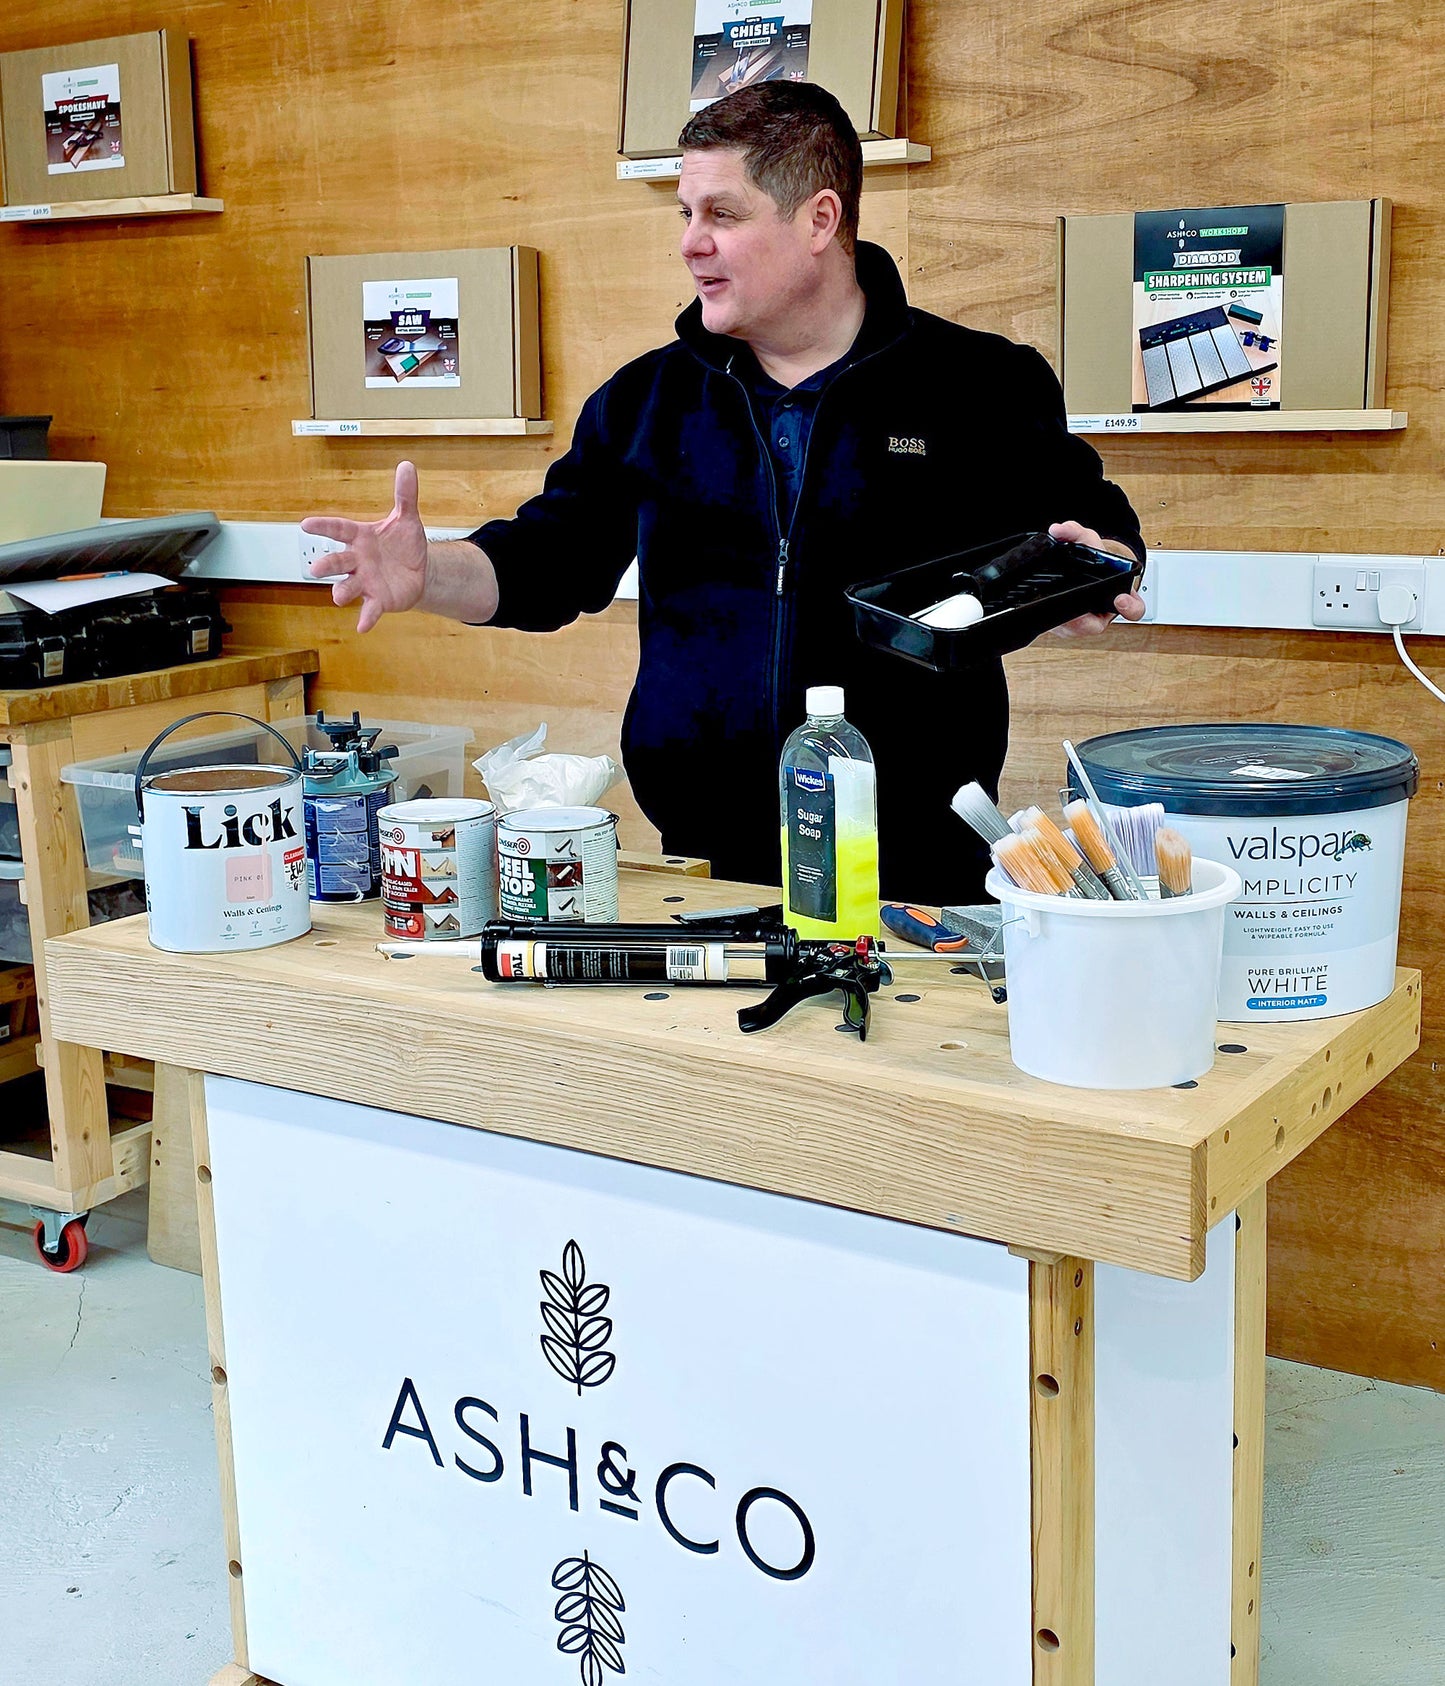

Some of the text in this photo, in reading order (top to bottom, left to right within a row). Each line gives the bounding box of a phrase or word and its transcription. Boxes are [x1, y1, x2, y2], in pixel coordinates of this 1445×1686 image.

[730, 23, 778, 39] CHISEL
[58, 100, 106, 114] SPOKESHAVE
[1179, 253, 1236, 265] DIAMOND
[1148, 270, 1266, 289] SHARPENING SYSTEM
[398, 314, 422, 326] SAW
[1105, 419, 1137, 427] £149.95
[888, 437, 925, 450] BOSS
[796, 773, 823, 787] Wickes
[181, 797, 297, 849] Lick
[797, 808, 824, 824] Sugar
[798, 824, 821, 840] Soap
[1227, 826, 1353, 867] valspar
[1244, 872, 1358, 896] MPLICITY
[223, 904, 283, 918] Walls & Ceilings
[1234, 905, 1343, 919] WALLS & CEILINGS
[1243, 926, 1293, 934] LIGHTWEIGHT,
[512, 952, 523, 977] DAL
[1248, 964, 1328, 976] PURE BRILLIANT
[1248, 974, 1327, 994] WHITE
[1258, 997, 1318, 1008] INTERIOR MATT
[381, 1377, 815, 1581] ASH&CO
